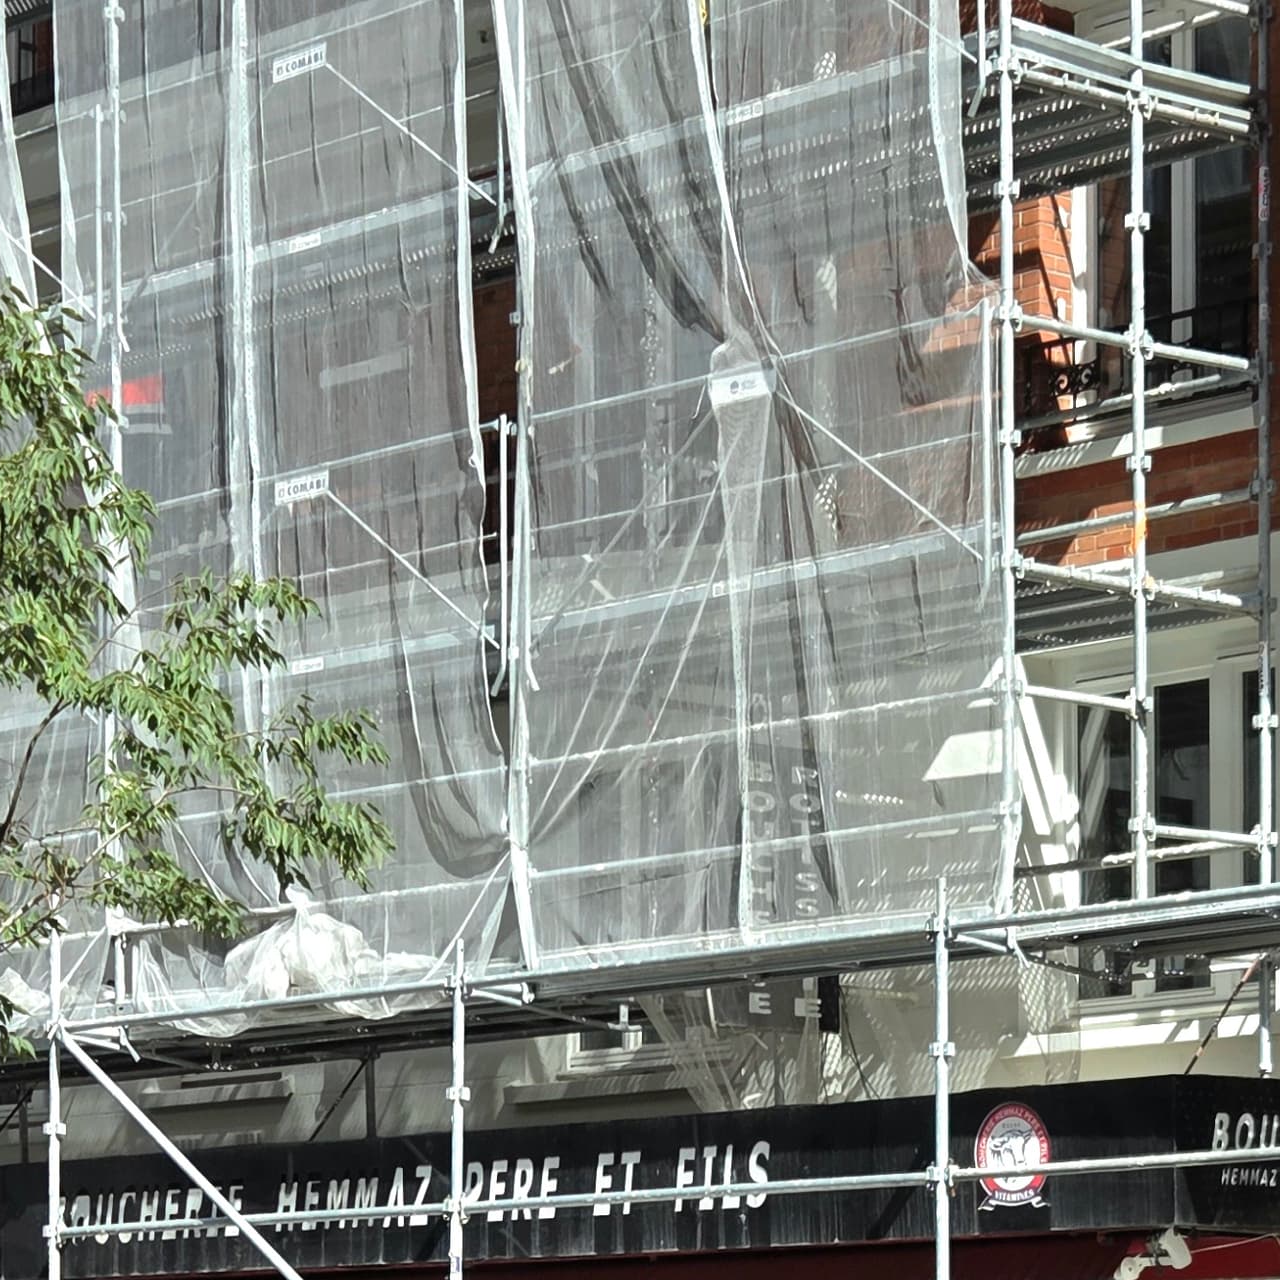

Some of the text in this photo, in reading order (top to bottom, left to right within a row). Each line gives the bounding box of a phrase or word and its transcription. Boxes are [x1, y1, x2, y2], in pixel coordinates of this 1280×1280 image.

[275, 1165, 433, 1233] HEMMAZ
[463, 1156, 561, 1222] PERE
[592, 1151, 642, 1217] ET
[673, 1140, 771, 1214] FILS
[1221, 1167, 1278, 1187] HEMMAZ
